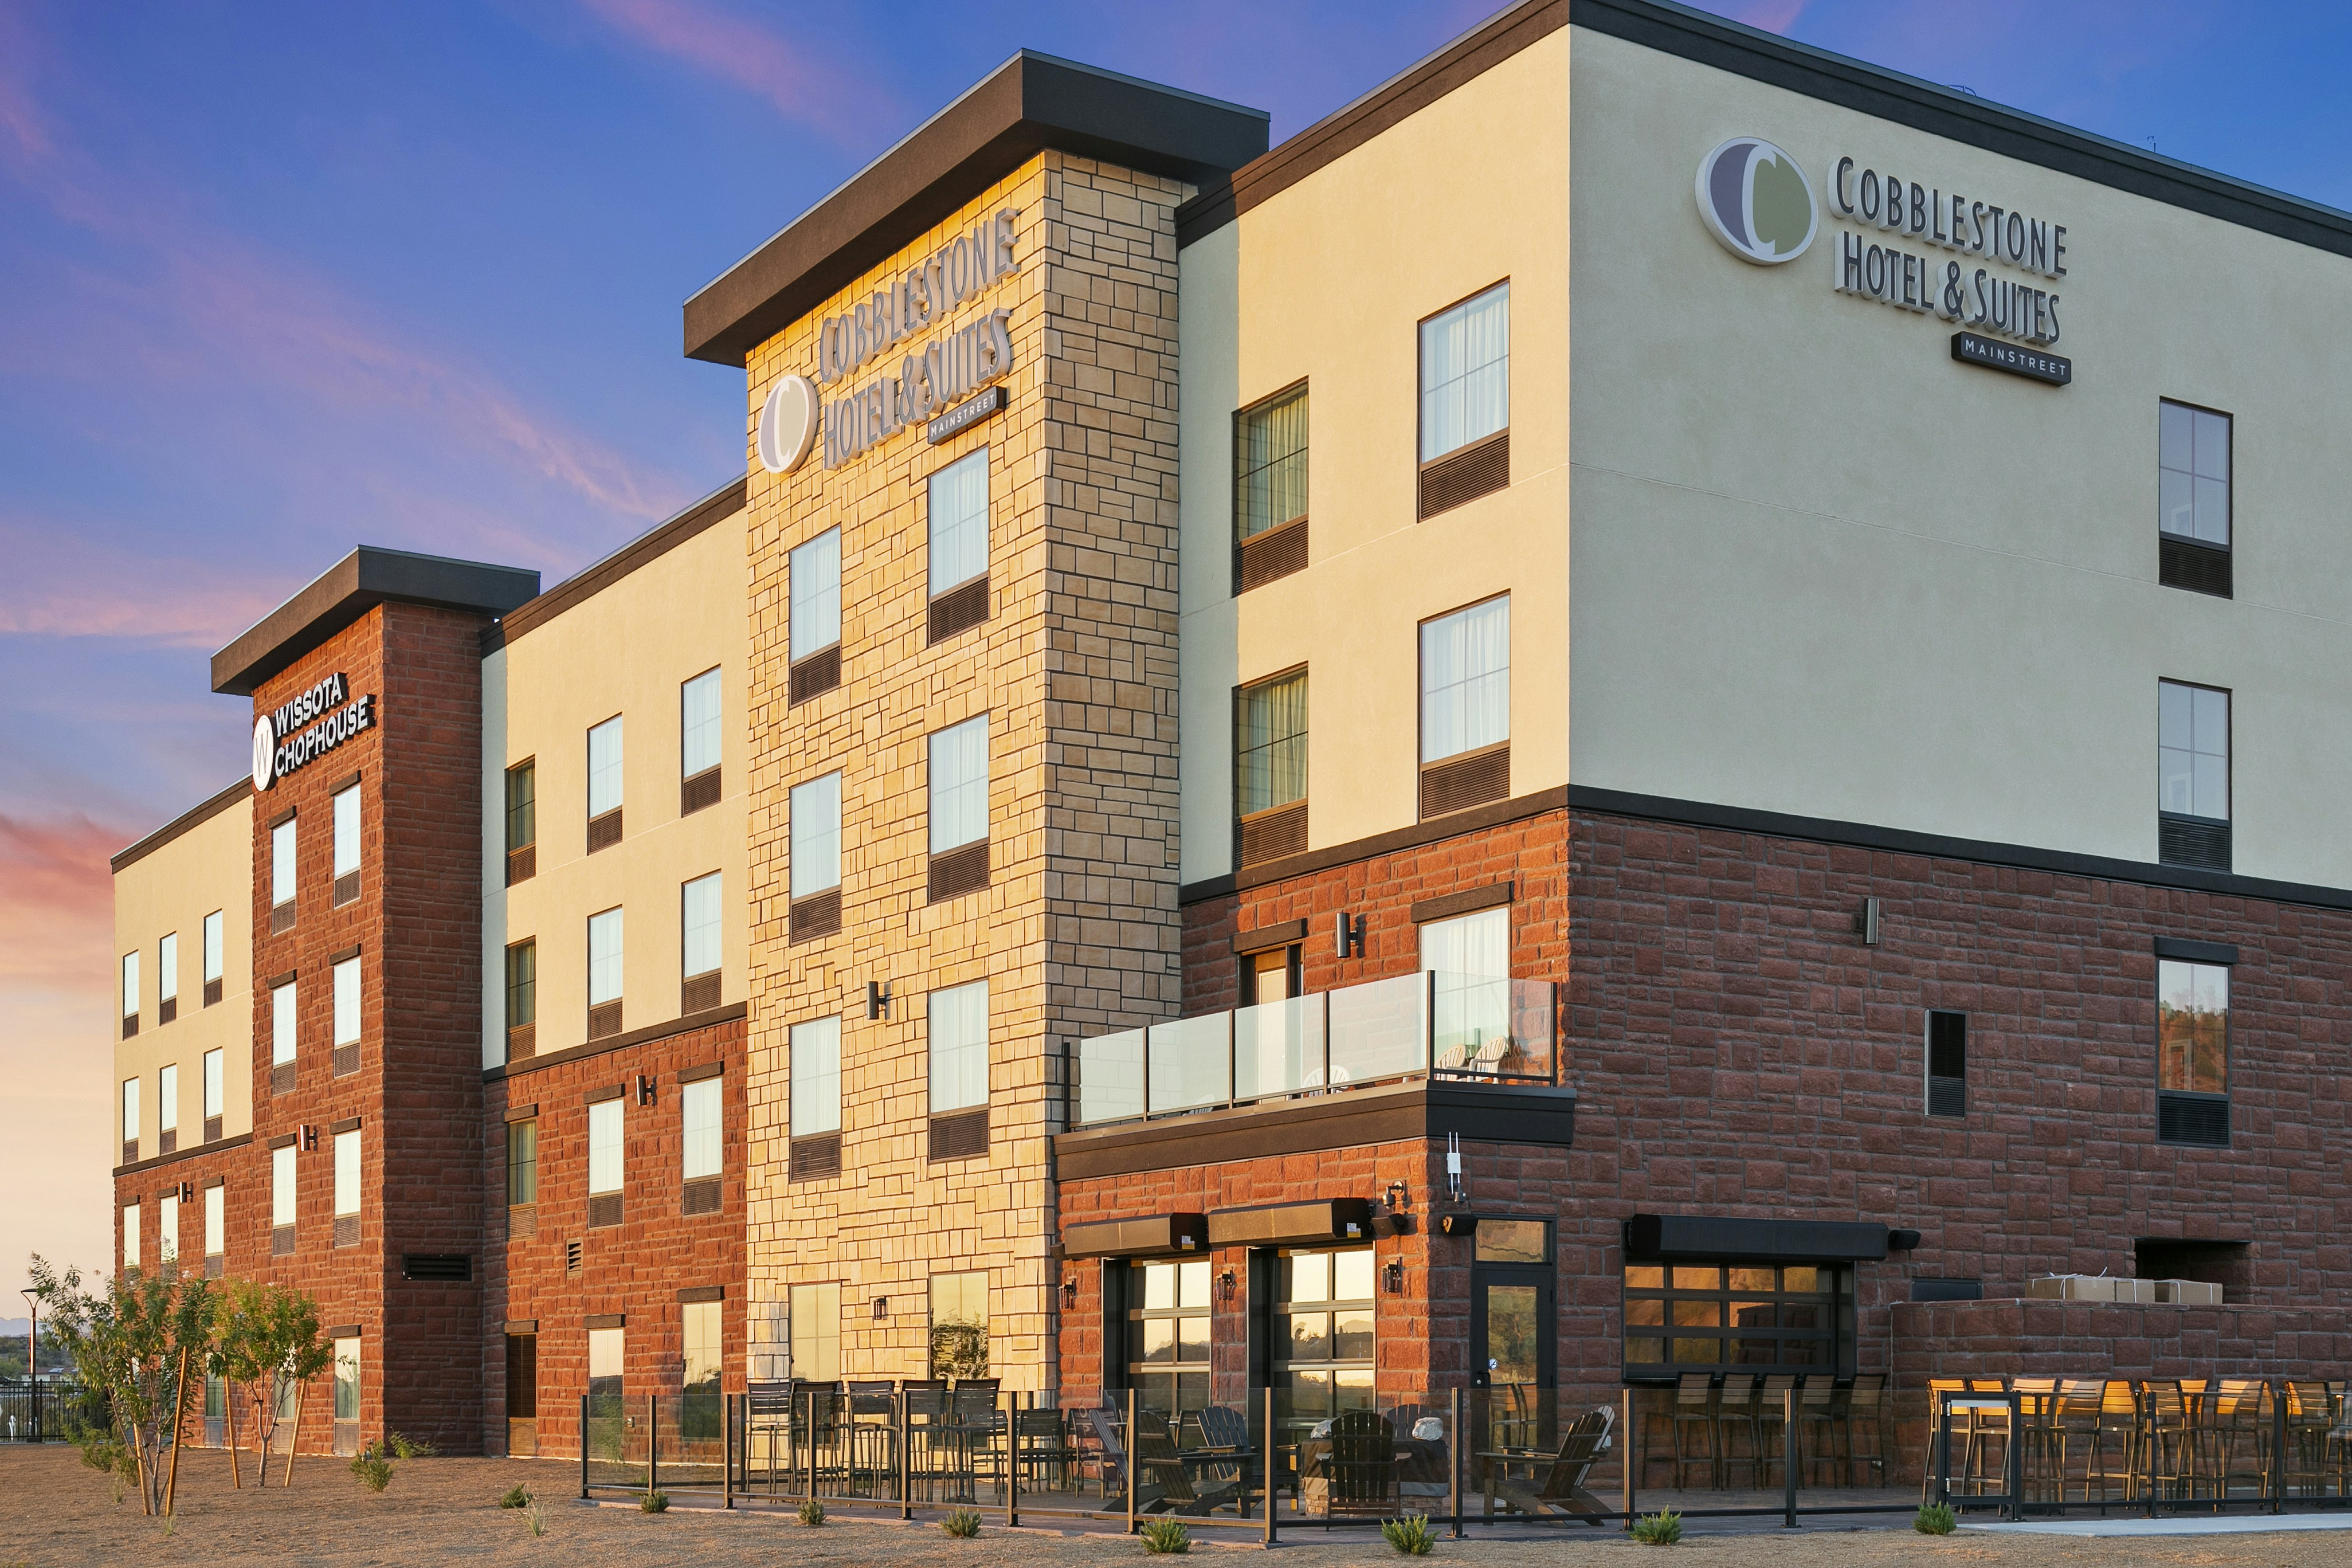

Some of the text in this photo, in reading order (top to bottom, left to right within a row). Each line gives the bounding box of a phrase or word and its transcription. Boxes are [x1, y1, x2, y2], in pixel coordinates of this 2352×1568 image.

[1836, 156, 2068, 277] COBBLESTONE
[820, 207, 1009, 385] COBBLESTONE
[1843, 230, 2061, 344] HOTEL & SUITES
[824, 307, 1009, 471] HOTEL & SUITES
[1965, 339, 2067, 377] MAINSTREET
[930, 394, 995, 438] MAINSTREET
[275, 672, 343, 738] WISSOTA
[275, 695, 369, 778] CHOPHOUSE
[255, 729, 270, 778] W
